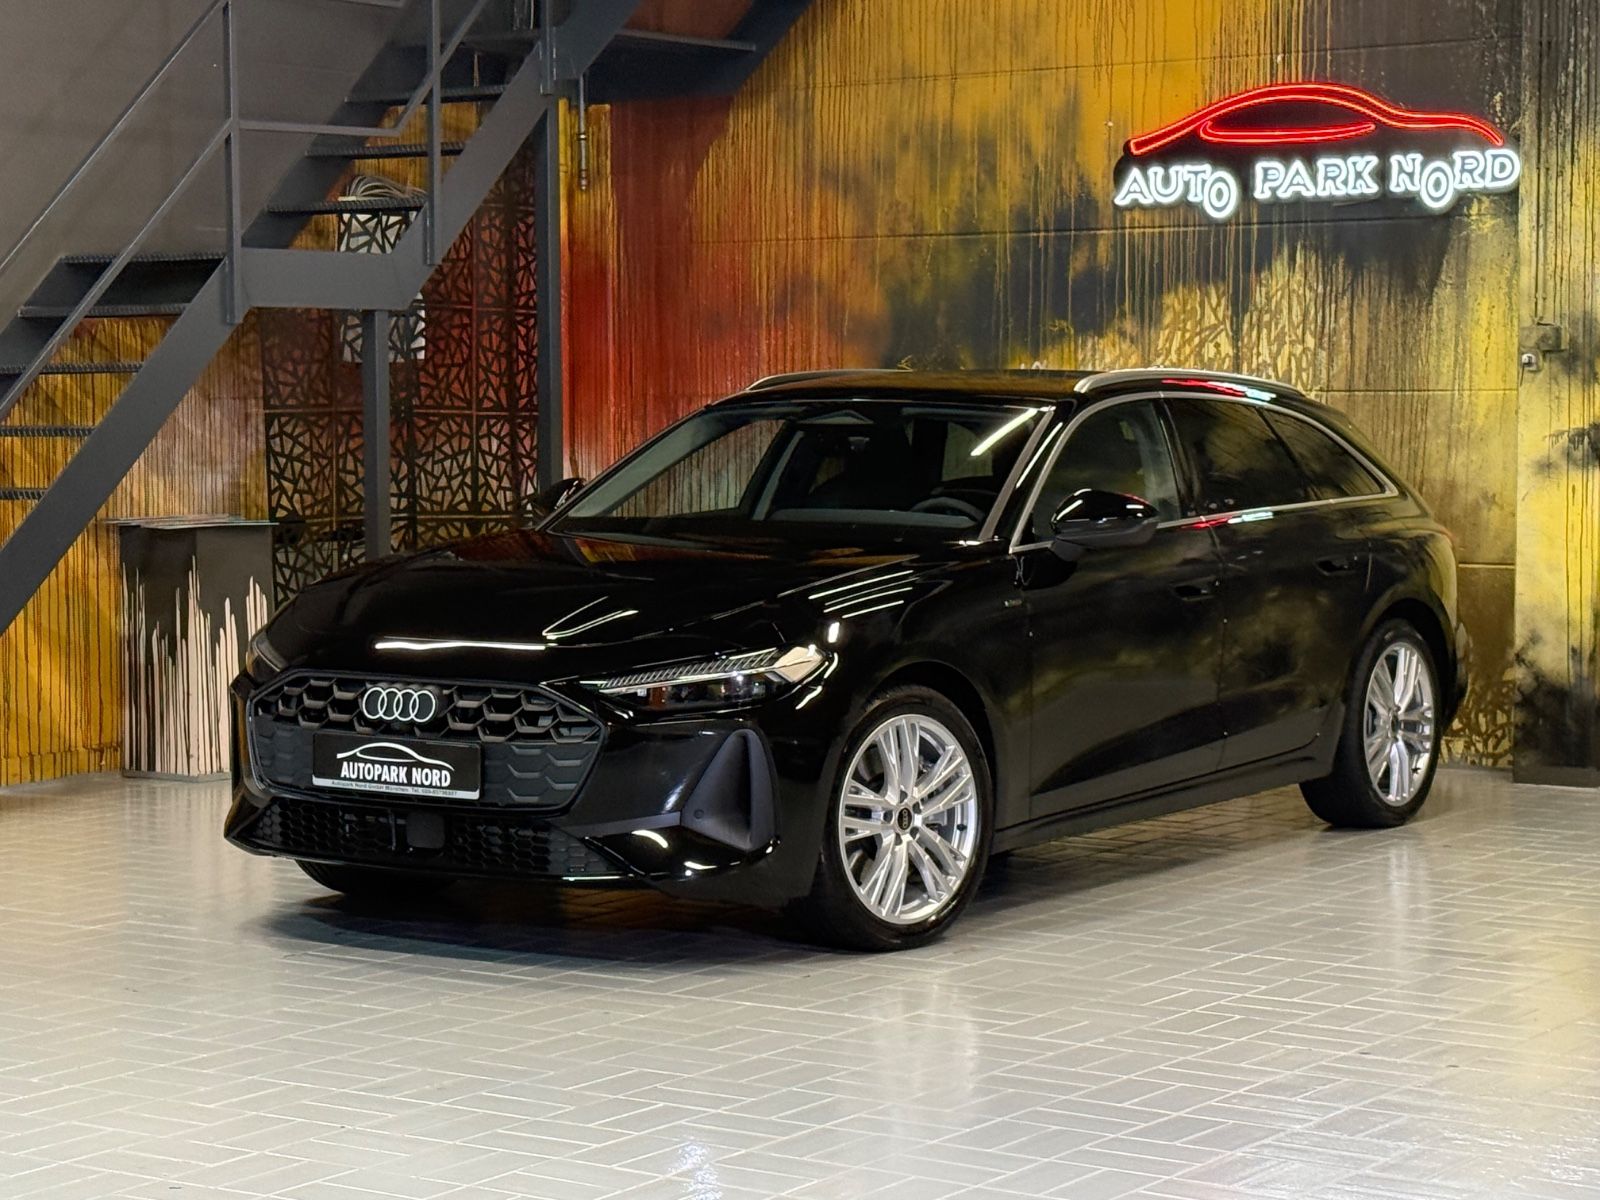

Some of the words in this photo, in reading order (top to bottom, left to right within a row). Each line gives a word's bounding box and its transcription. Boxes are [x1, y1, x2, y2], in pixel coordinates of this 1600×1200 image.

[1115, 166, 1238, 218] AUTO
[1253, 156, 1379, 199] PARK
[1389, 149, 1521, 208] NORD
[340, 761, 408, 783] AUTOPARK
[411, 768, 451, 787] NORD
